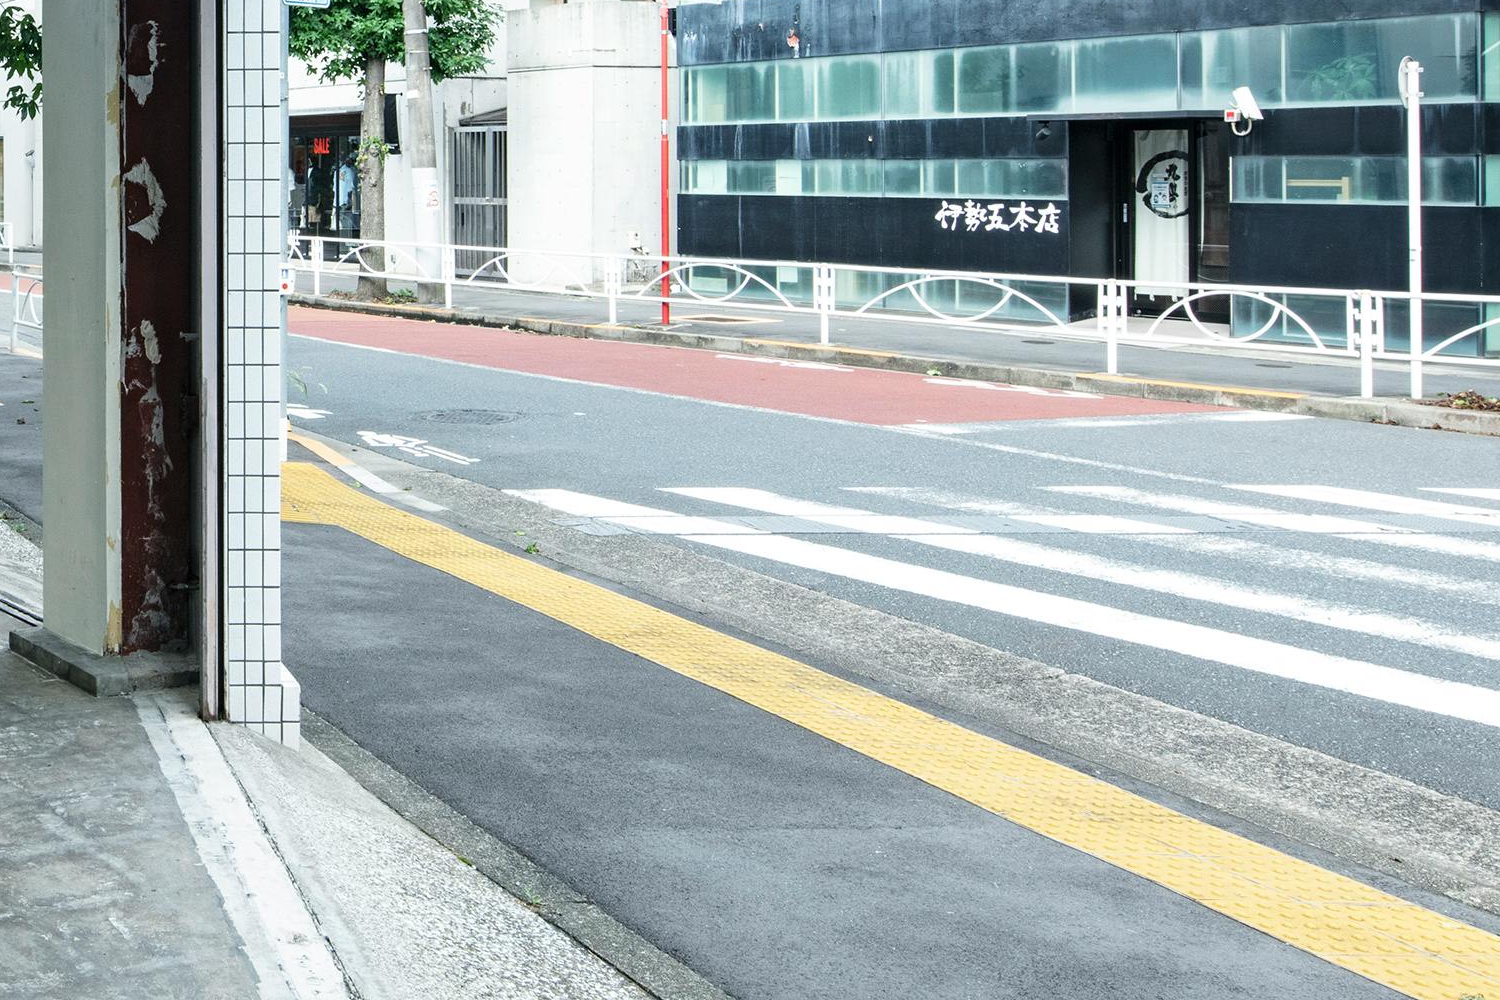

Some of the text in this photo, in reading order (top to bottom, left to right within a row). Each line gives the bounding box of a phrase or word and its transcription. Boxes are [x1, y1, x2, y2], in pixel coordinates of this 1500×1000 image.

[313, 137, 330, 154] SALE
[934, 199, 1062, 234] 伊勢五本店
